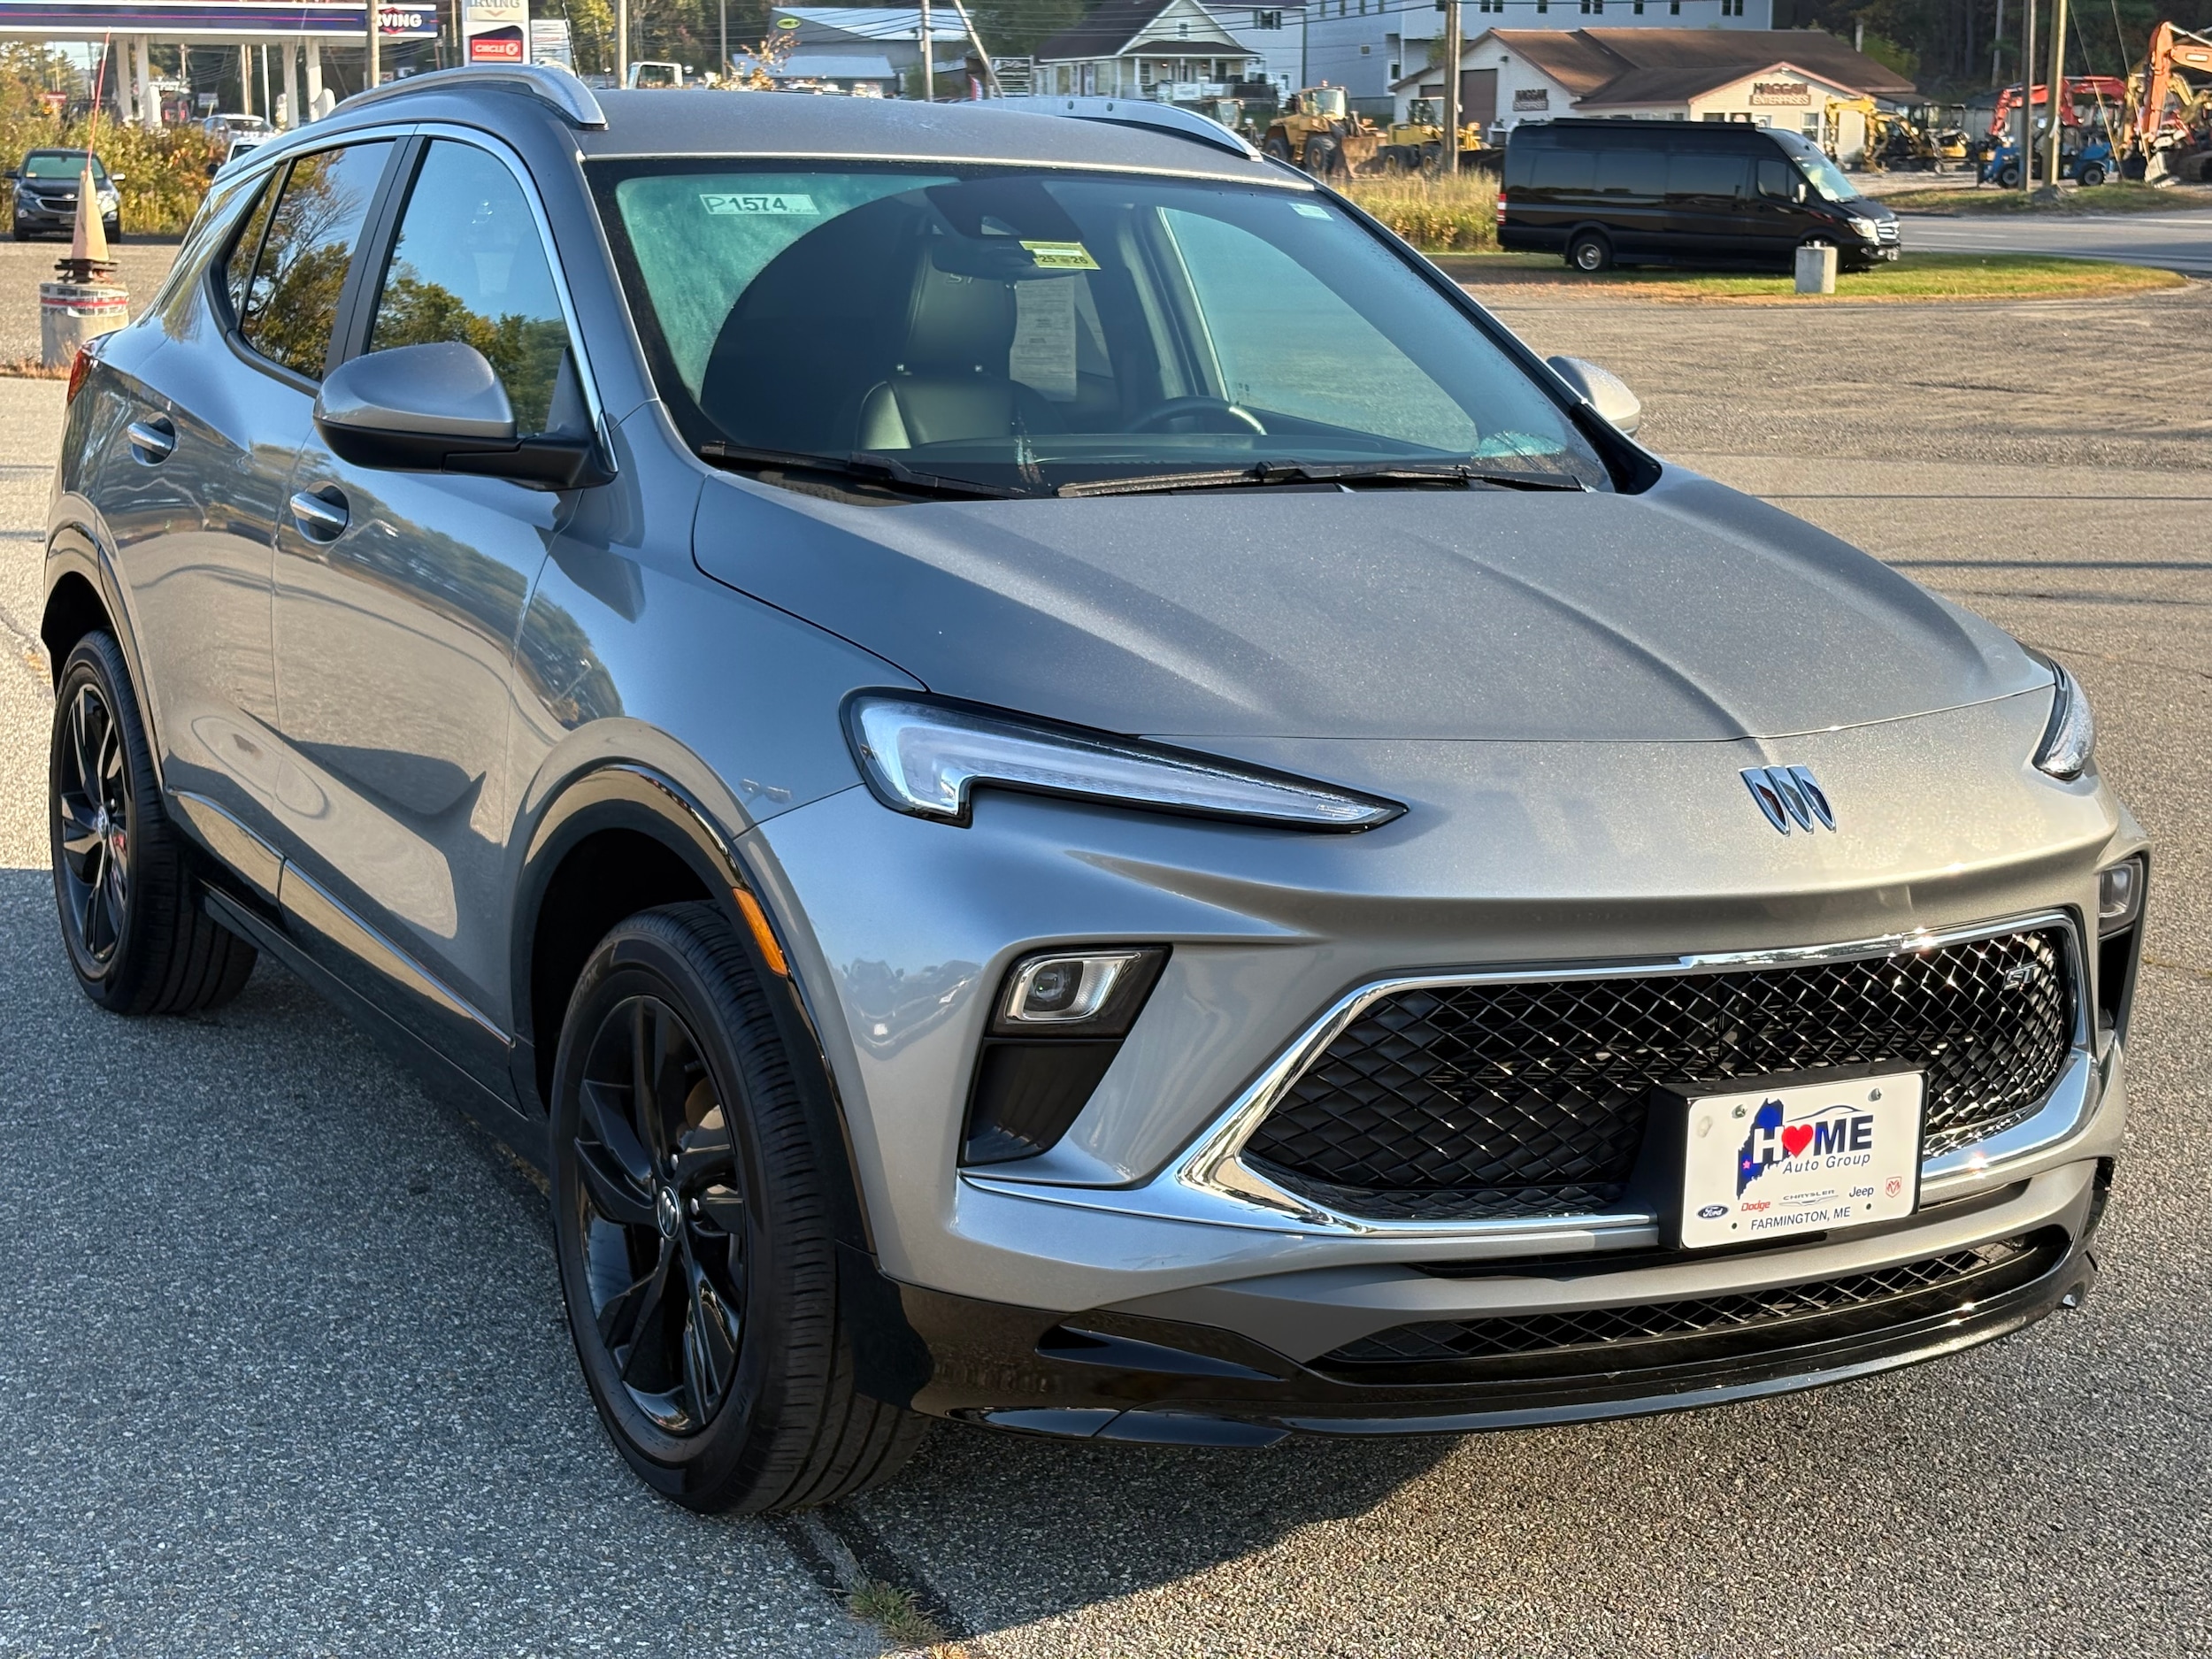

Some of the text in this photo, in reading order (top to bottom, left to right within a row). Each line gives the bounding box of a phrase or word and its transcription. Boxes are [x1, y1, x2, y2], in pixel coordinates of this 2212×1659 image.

[474, 44, 505, 53] CIRCLE
[1782, 1154, 1870, 1174] Auto Group
[1783, 1189, 1835, 1201] CHRYSLER
[1848, 1187, 1874, 1199] Jeep
[1702, 1205, 1724, 1217] Ford
[1740, 1200, 1771, 1213] Dodge
[1751, 1206, 1851, 1230] FARMINGTON, ME
